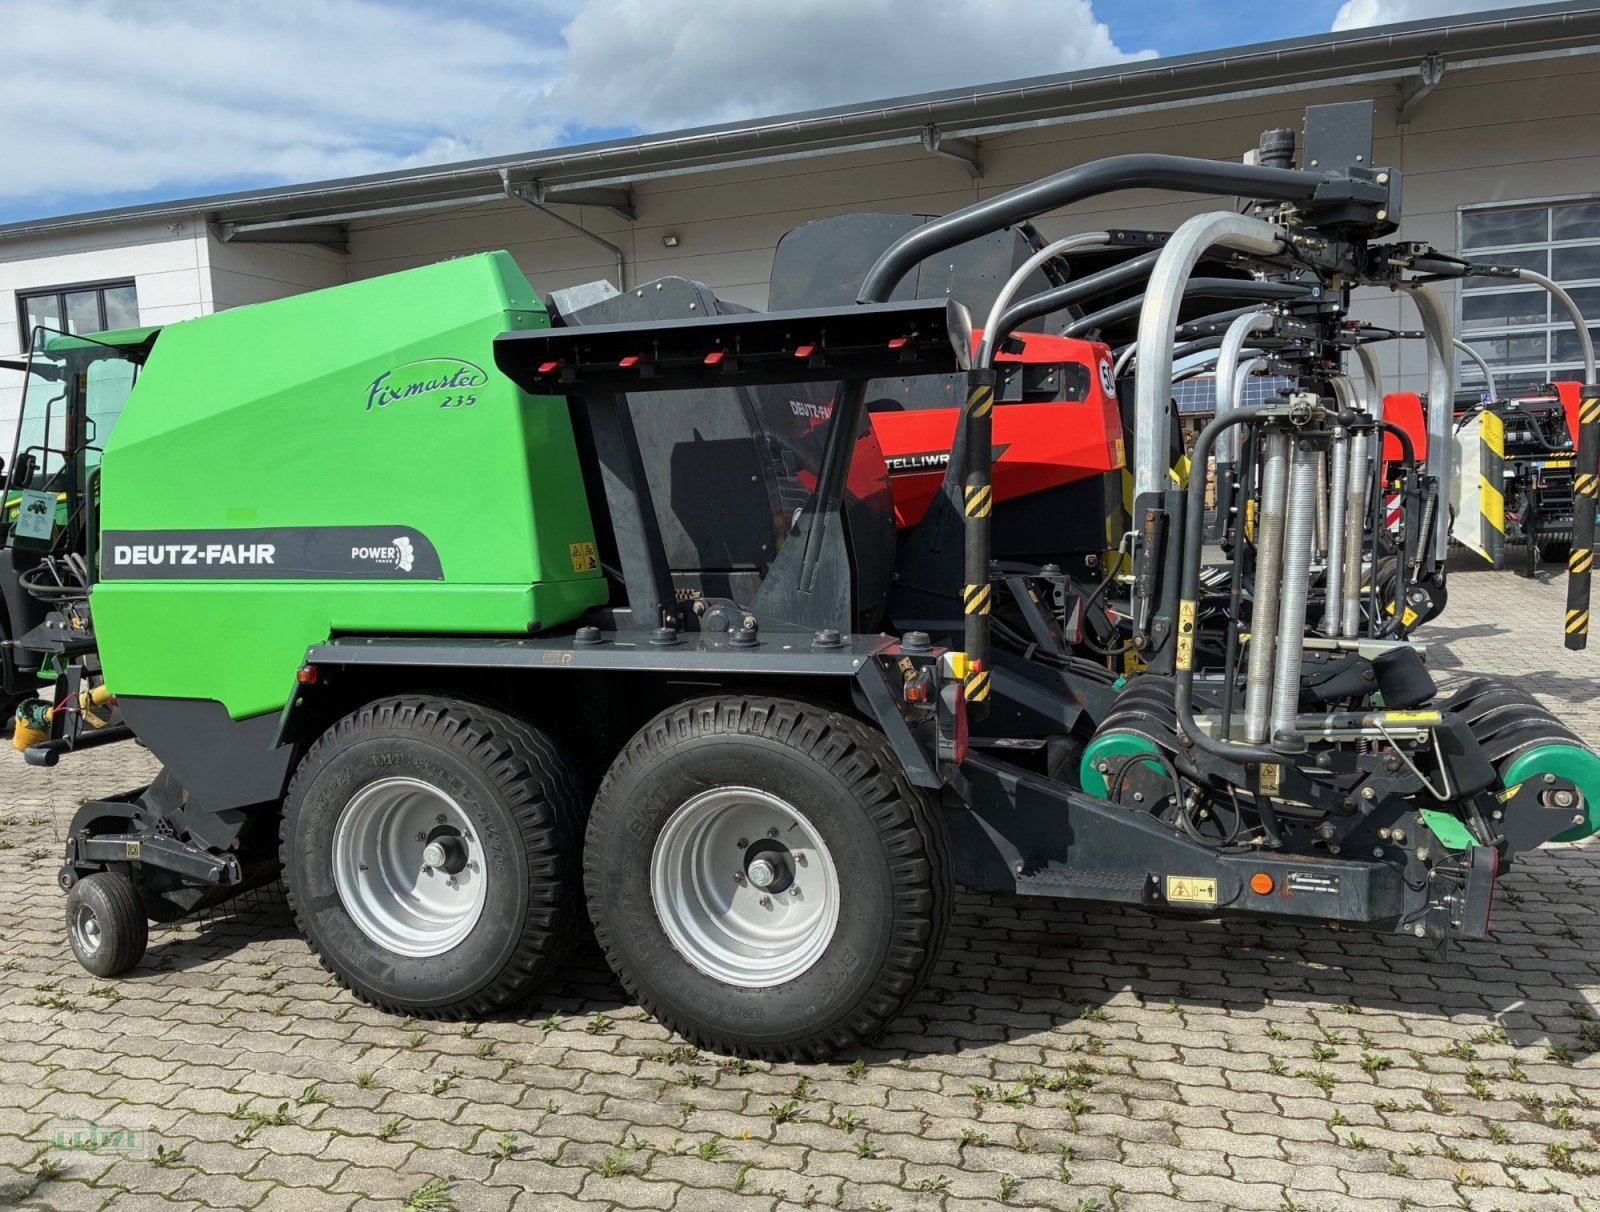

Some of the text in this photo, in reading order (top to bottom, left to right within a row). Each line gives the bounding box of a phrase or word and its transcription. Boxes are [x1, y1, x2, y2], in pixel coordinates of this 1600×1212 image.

[364, 367, 487, 411] Fixmaster
[440, 394, 477, 409] 235
[114, 544, 275, 565] DEUTZ-FAHR
[351, 547, 396, 560] POWER
